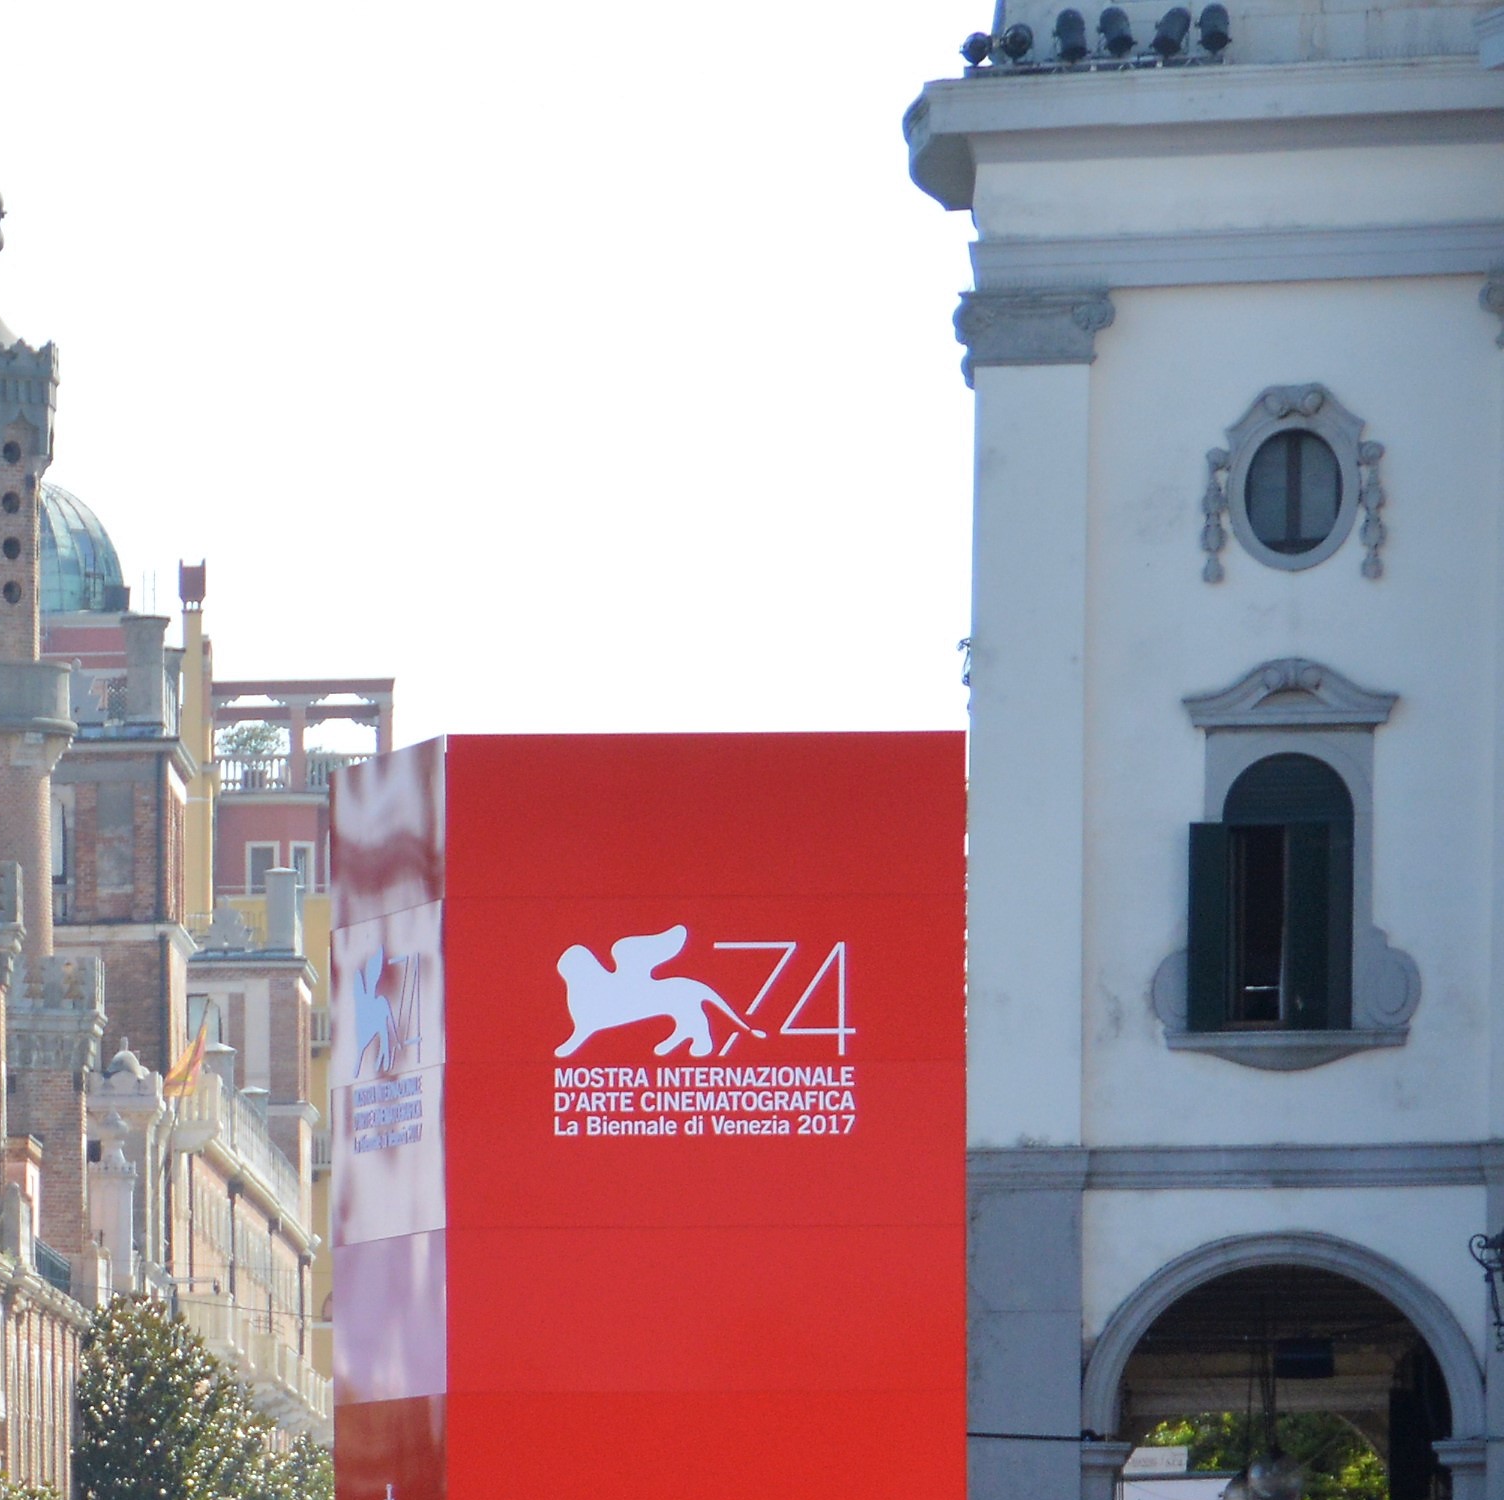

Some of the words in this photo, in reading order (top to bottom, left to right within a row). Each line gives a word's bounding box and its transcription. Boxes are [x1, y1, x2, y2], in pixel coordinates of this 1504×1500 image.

[714, 941, 856, 1056] 74
[554, 1067, 648, 1087] MOSTRA
[656, 1066, 855, 1087] INTERNAZIONALE
[640, 1090, 856, 1112] CINEMATOGRAFICA
[554, 1116, 578, 1136] La
[586, 1115, 677, 1135] Biennale
[684, 1115, 703, 1135] di
[711, 1115, 790, 1135] Venezia
[797, 1115, 856, 1135] 2017
